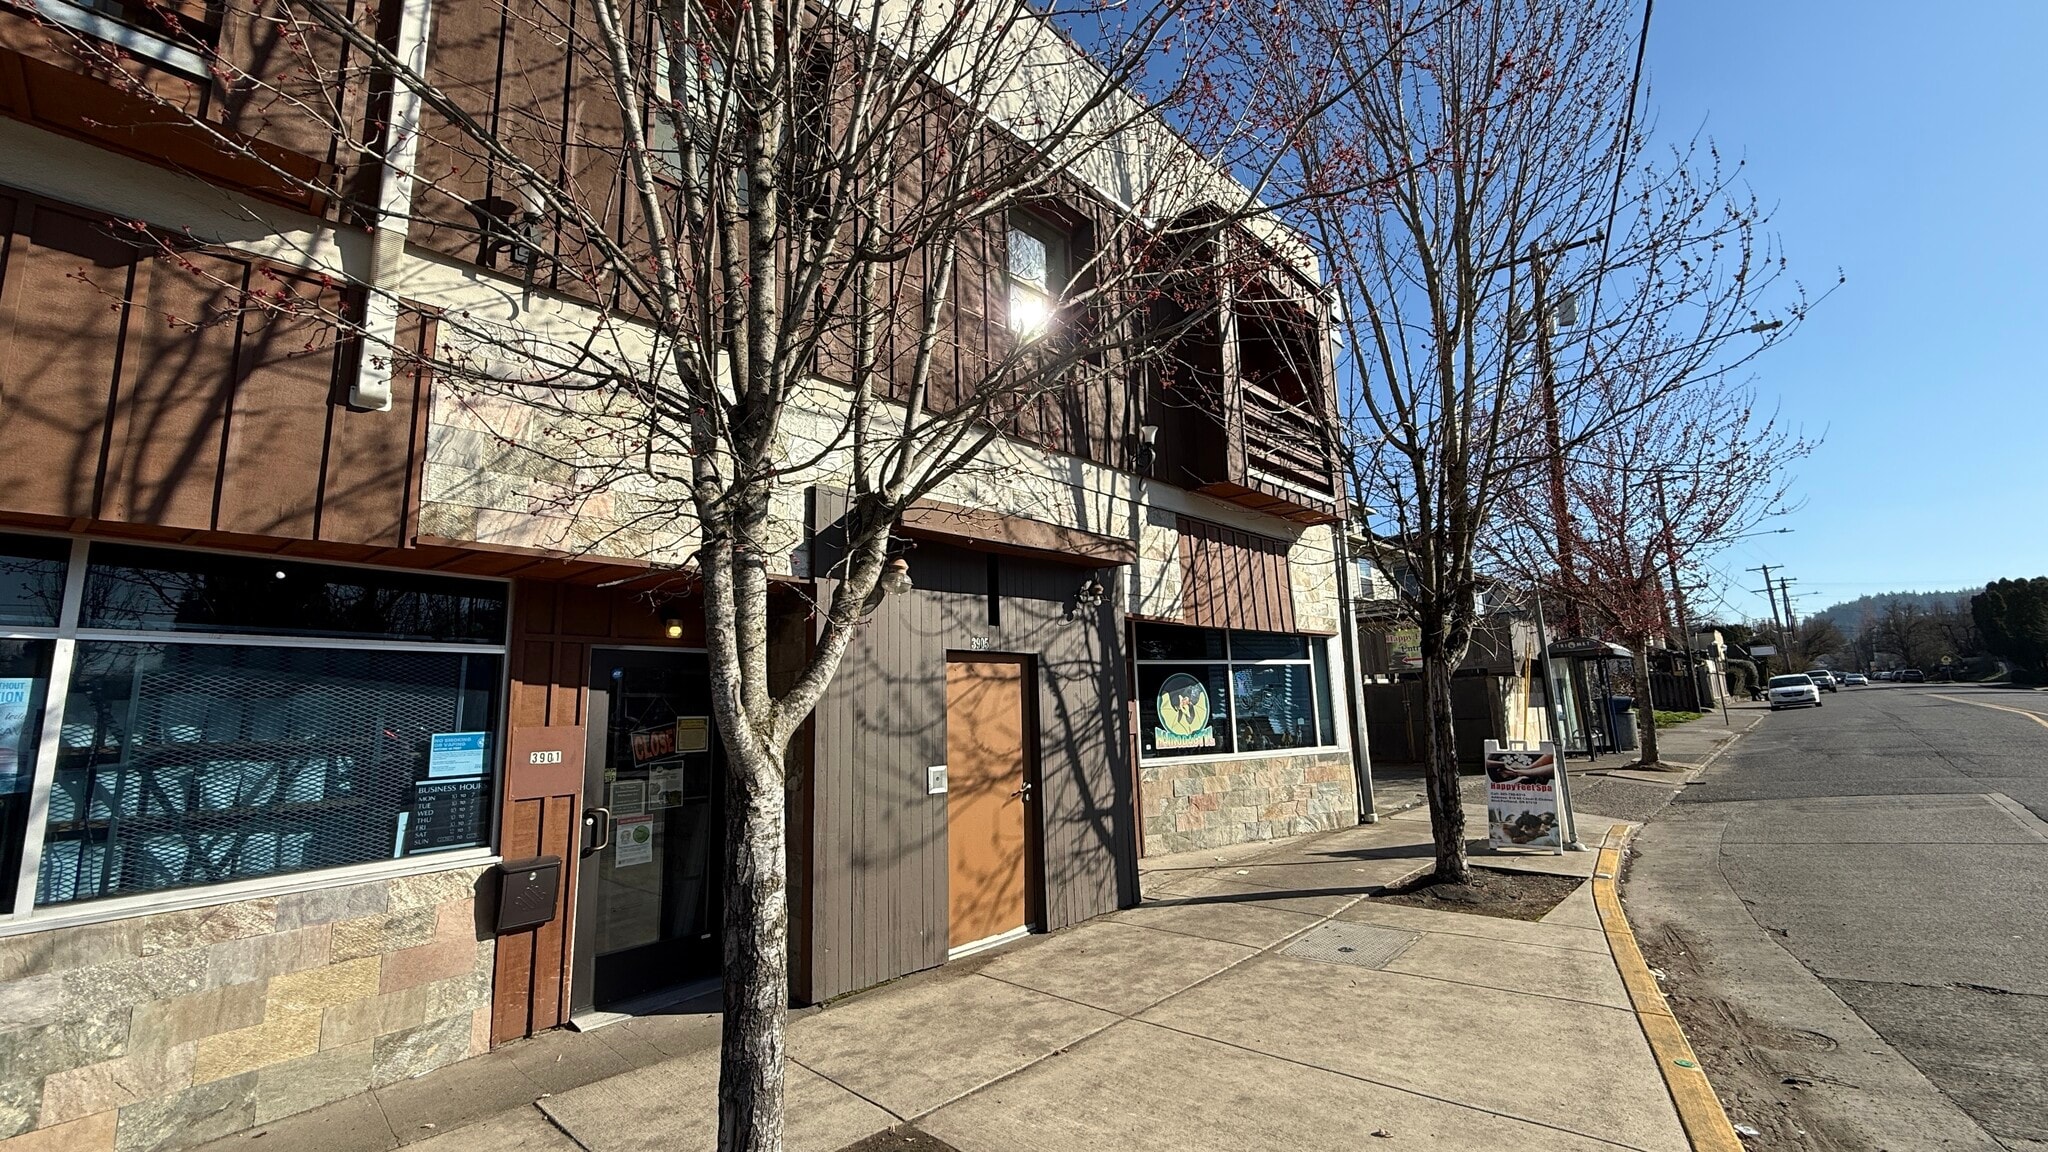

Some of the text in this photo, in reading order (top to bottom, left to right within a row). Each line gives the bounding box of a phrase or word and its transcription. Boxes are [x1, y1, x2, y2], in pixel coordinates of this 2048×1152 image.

[971, 637, 990, 650] 3905
[634, 727, 677, 761] CLOSE
[531, 752, 560, 763] 3901
[418, 784, 457, 794] BUSINESS
[1490, 782, 1553, 792] Happy Feet Spa
[417, 809, 434, 817] WED
[415, 831, 427, 839] SAT
[414, 838, 429, 846] SUN
